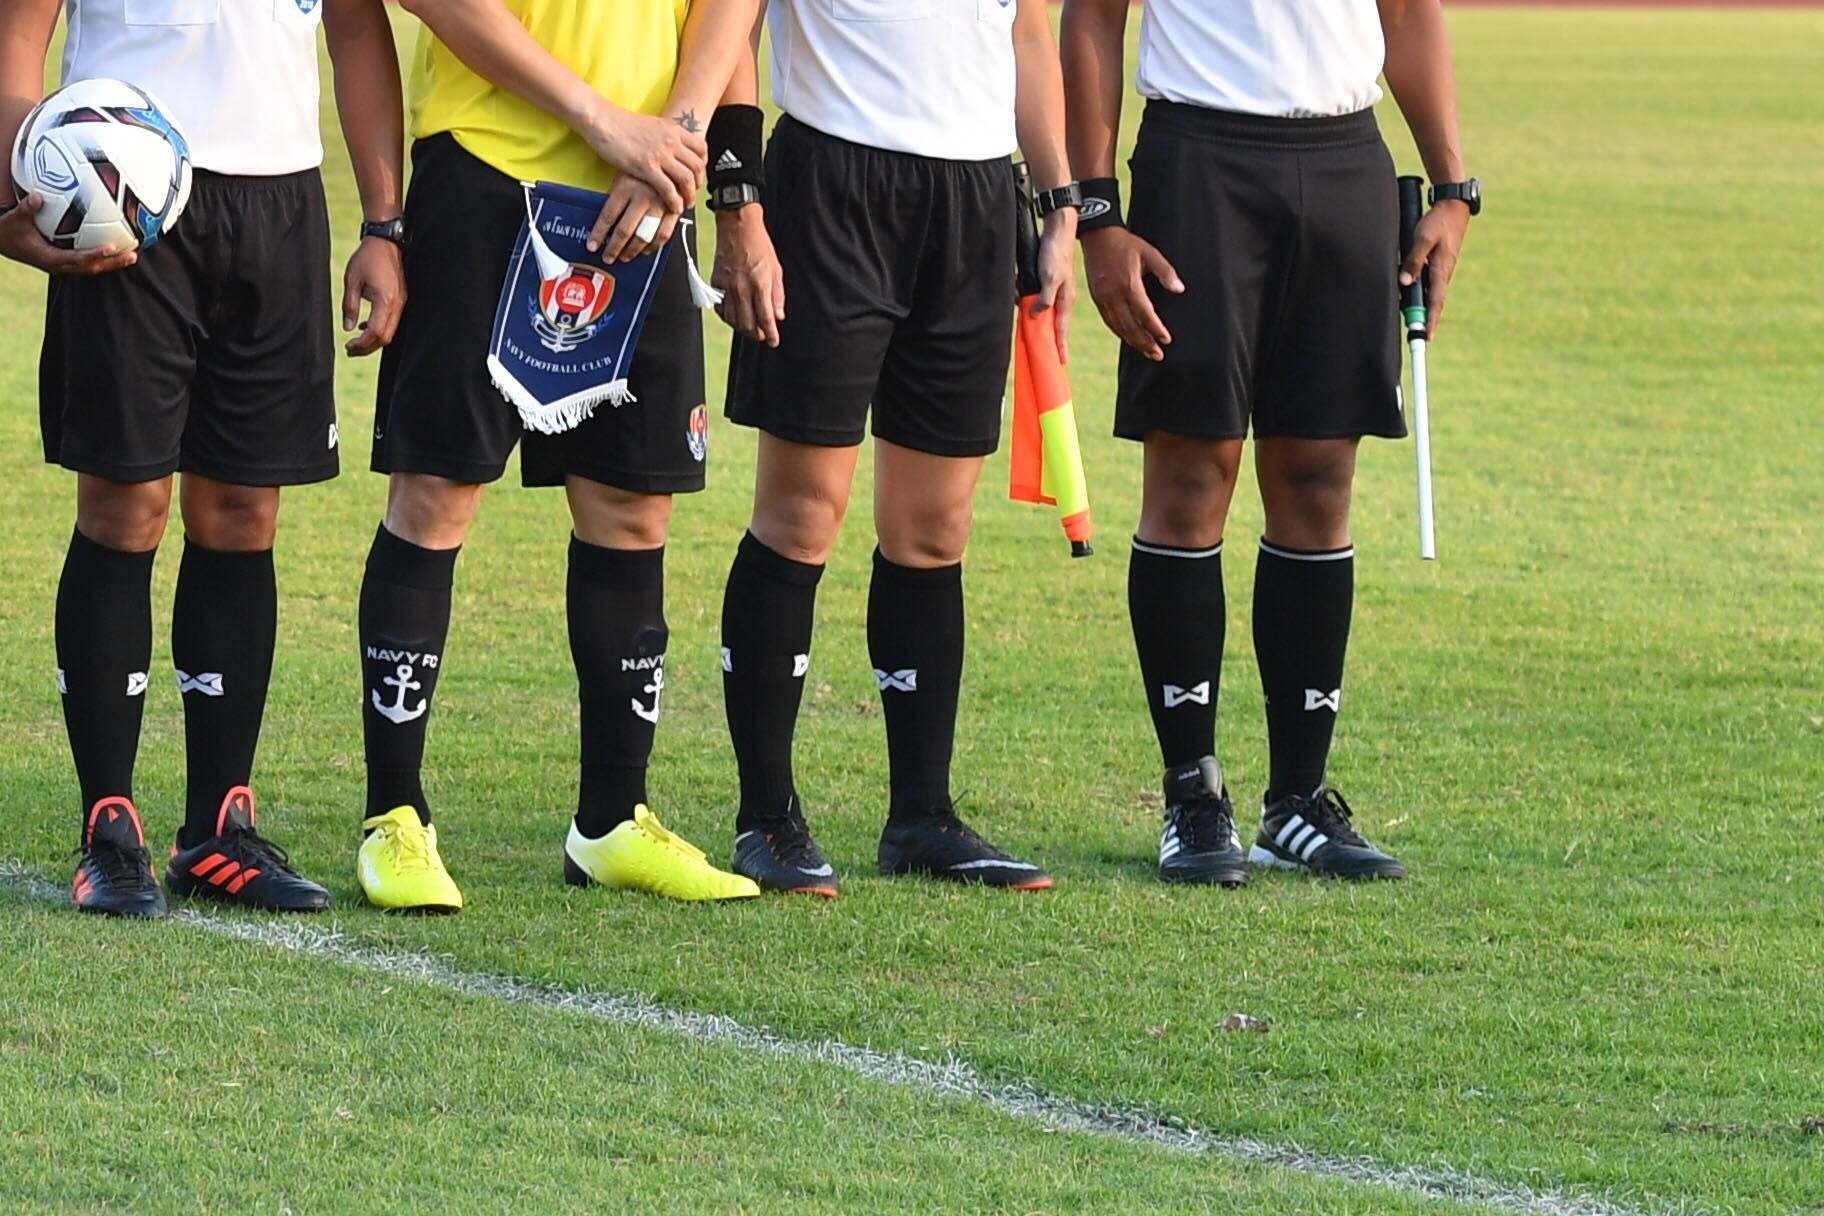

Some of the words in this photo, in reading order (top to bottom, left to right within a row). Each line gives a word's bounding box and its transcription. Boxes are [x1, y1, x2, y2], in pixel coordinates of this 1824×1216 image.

[524, 355, 581, 374] FOOTBALL
[581, 355, 613, 372] CLUB
[367, 646, 421, 665] NAVY
[421, 653, 439, 669] FC
